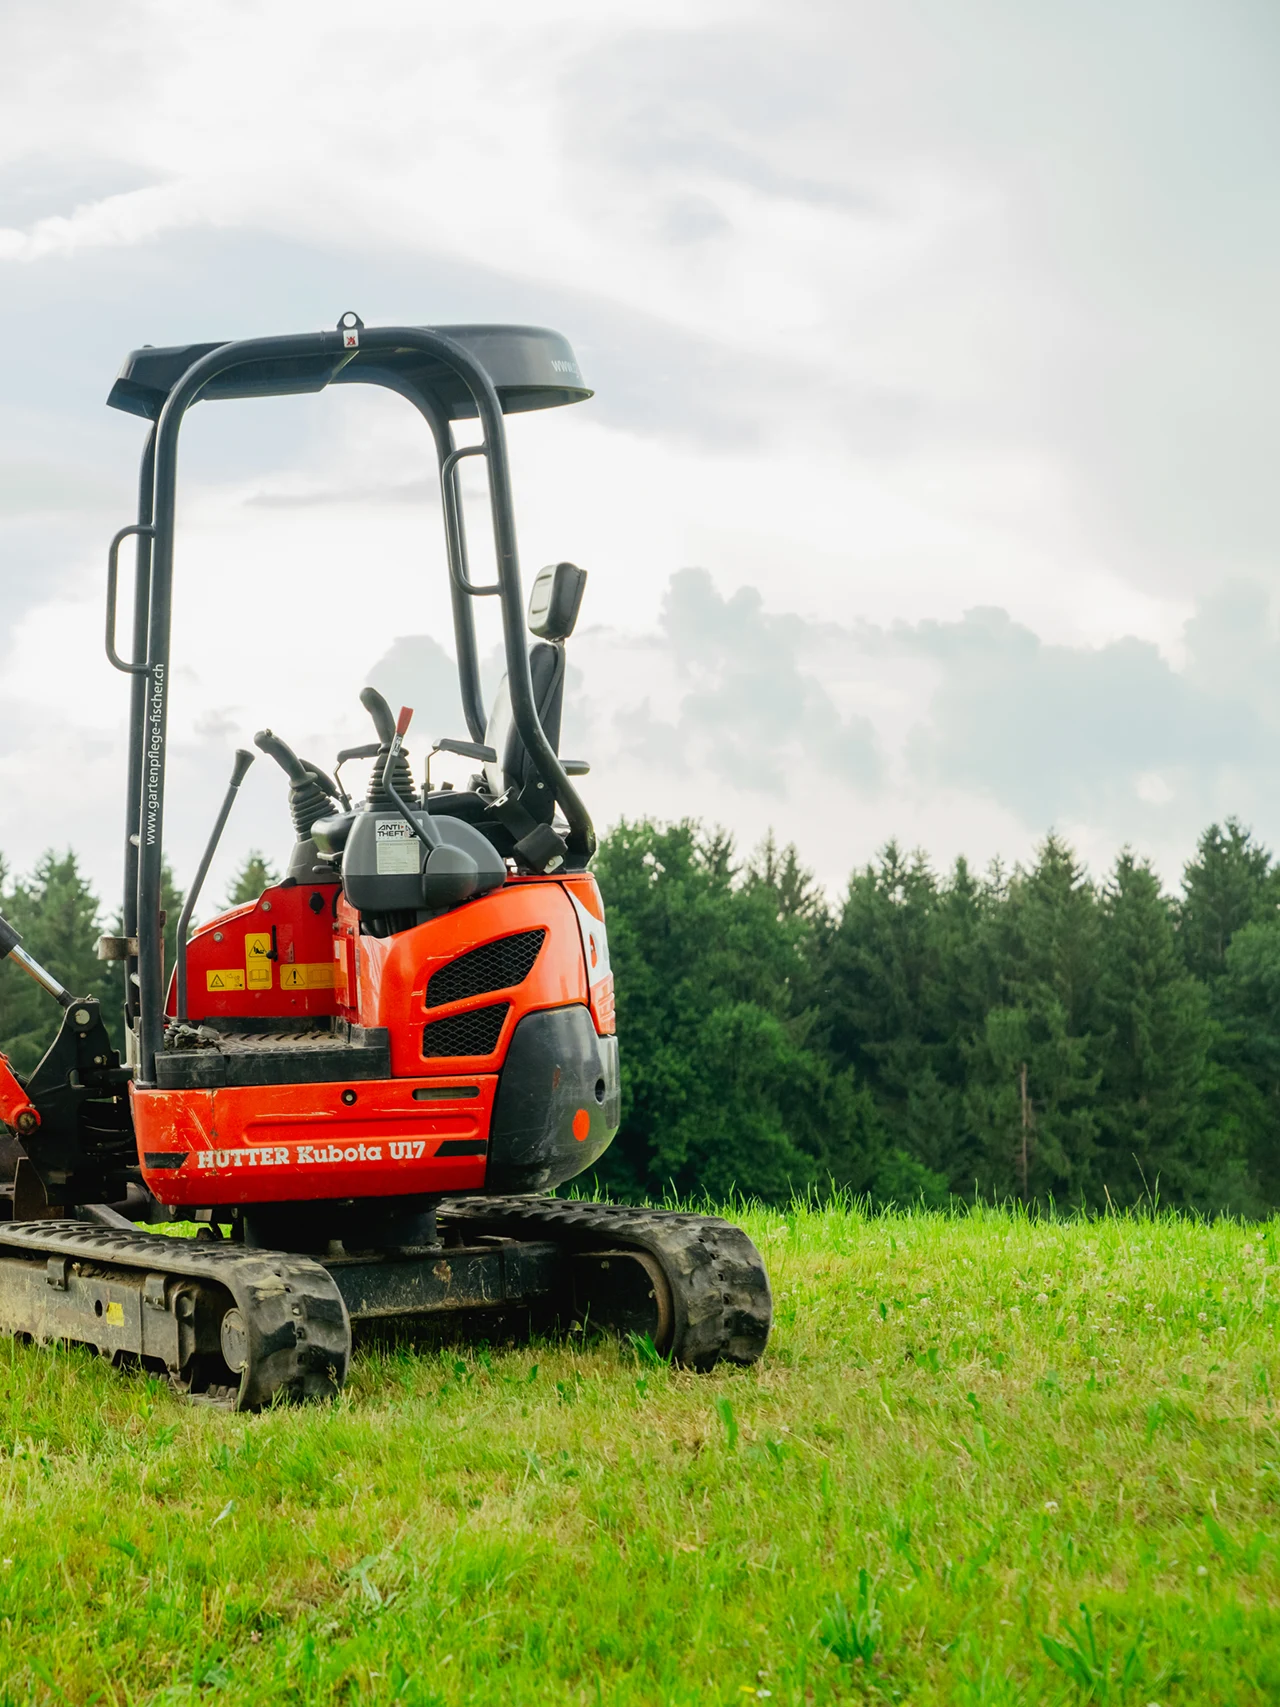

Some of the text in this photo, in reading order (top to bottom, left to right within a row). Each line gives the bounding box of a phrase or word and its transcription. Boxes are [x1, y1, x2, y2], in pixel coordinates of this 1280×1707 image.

[147, 663, 164, 845] www.gartenpflege-fischer.ch
[296, 1144, 382, 1164] Kubota
[389, 1141, 426, 1160] U17
